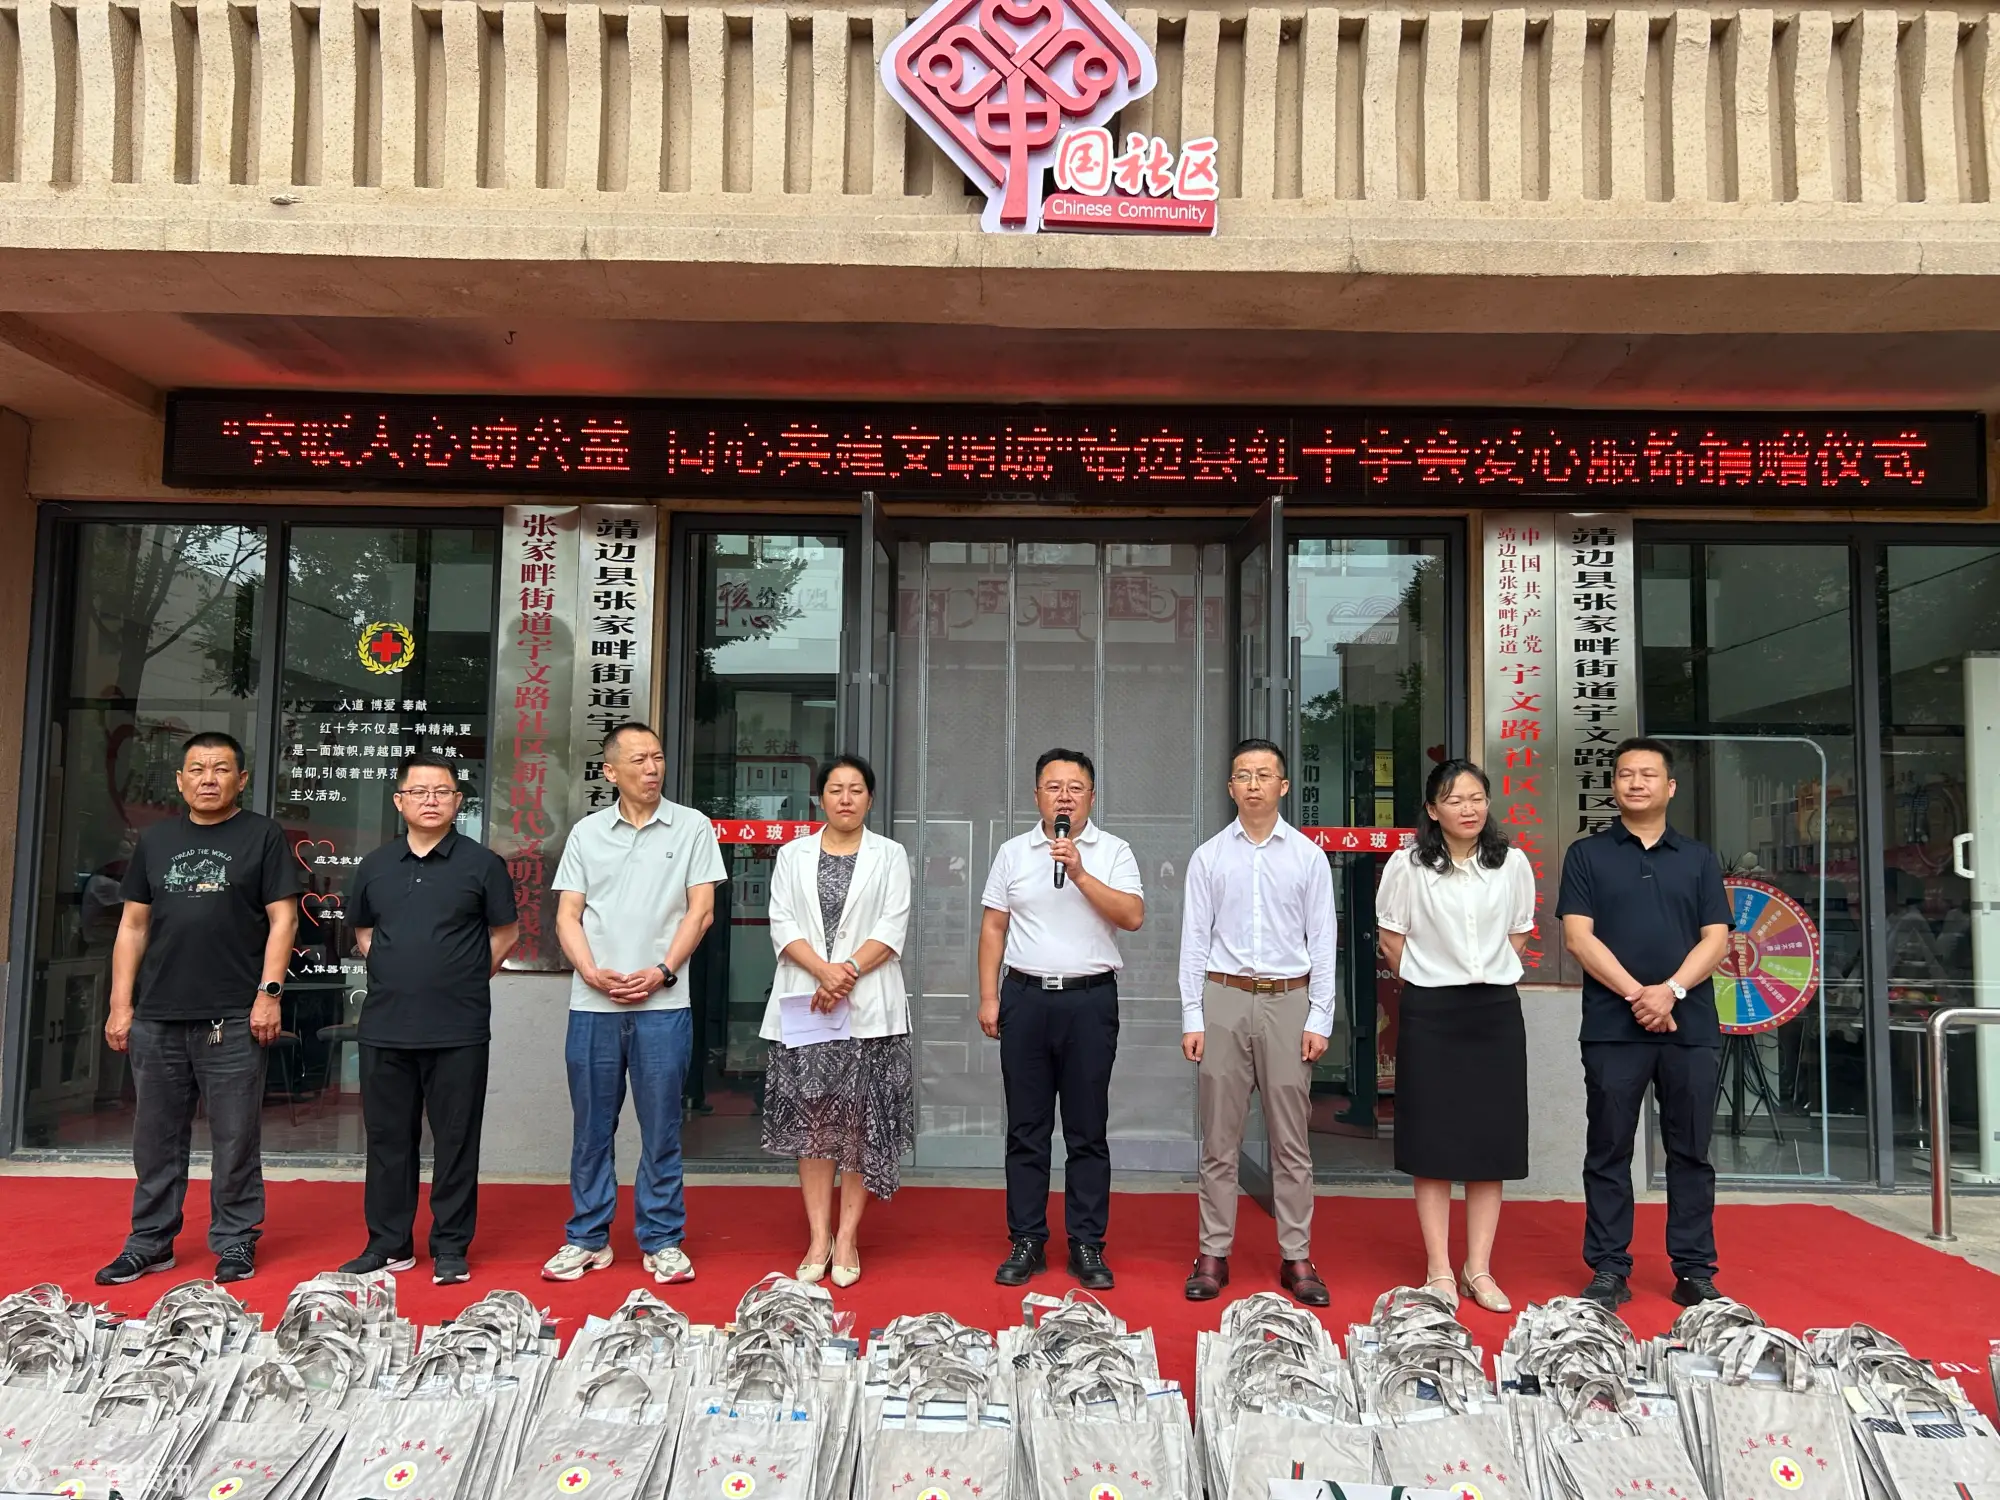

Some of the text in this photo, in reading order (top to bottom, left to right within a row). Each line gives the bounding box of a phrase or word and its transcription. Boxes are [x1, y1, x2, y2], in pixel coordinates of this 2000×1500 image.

[1052, 200, 1207, 223] Chinese Community
[1497, 527, 1518, 654] 靖边县张家畔街道
[1521, 527, 1542, 653] 中国共产党
[339, 699, 428, 711] 人道 博爱 奉献
[1302, 744, 1319, 802] 我们的
[290, 789, 347, 802] 主义活动。
[212, 849, 232, 861] WORLD
[301, 965, 367, 974] 人体器官捐
